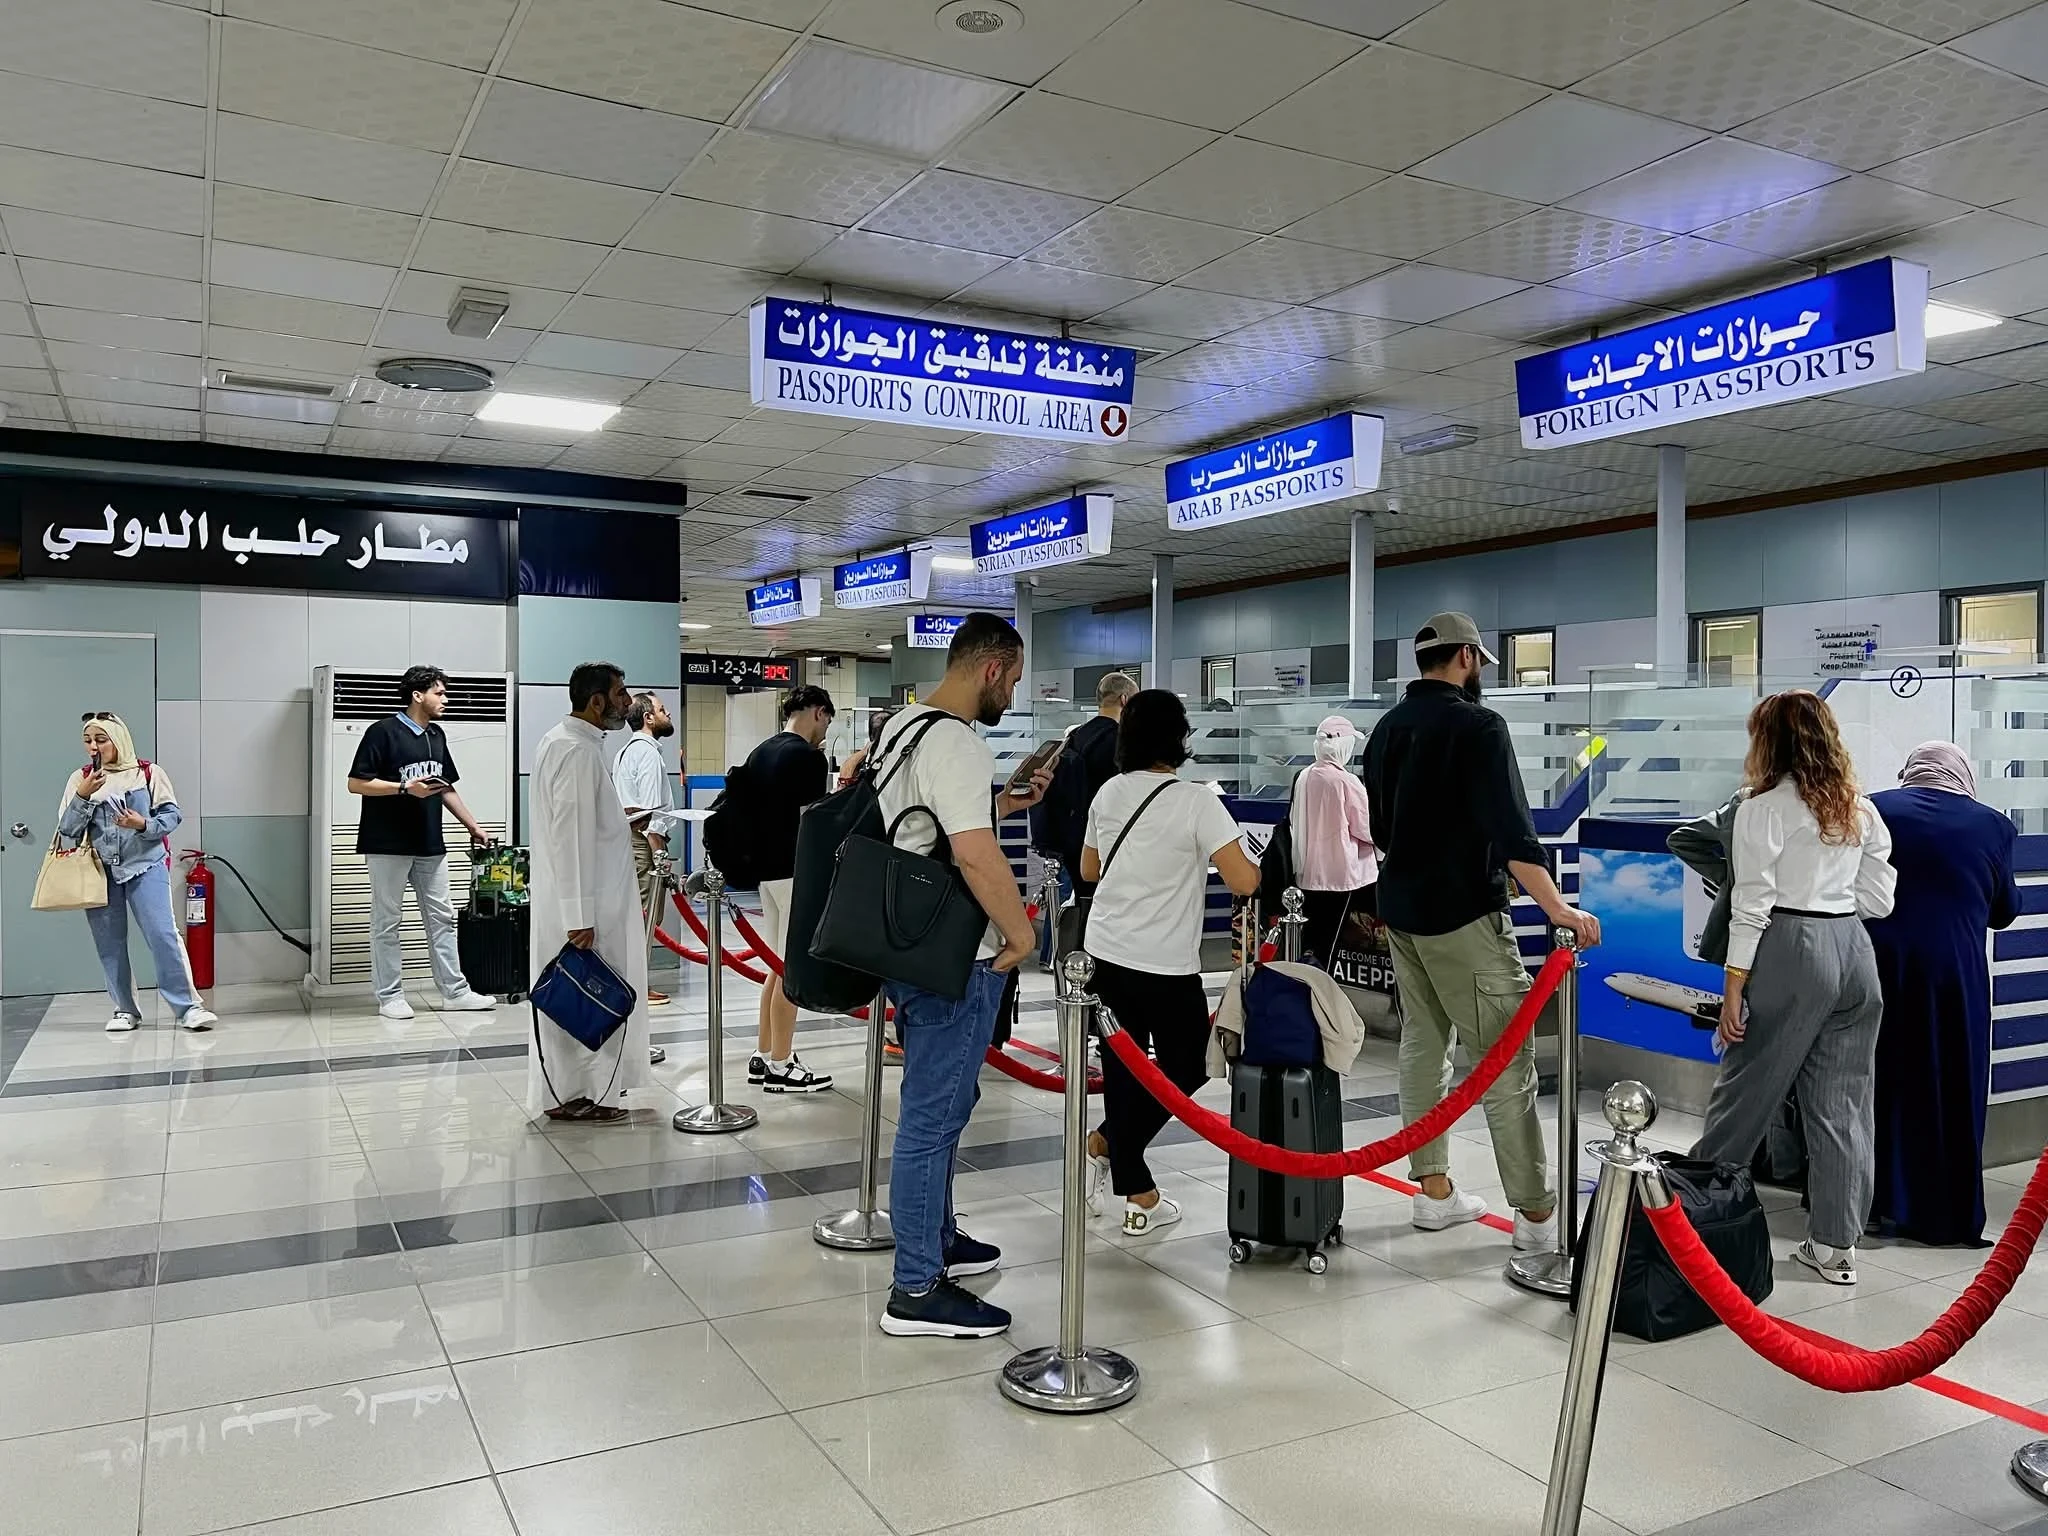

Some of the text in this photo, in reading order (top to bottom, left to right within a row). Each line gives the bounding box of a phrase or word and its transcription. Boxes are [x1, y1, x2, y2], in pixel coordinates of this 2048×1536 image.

[778, 307, 1124, 388] منطقة تدقيق الجوازات
[1566, 309, 1821, 400] جوازات الاجانب
[777, 366, 1094, 433] PASSPORTS CONTROL AREA
[1535, 340, 1876, 440] FOREIGN PASSPORTS
[1189, 438, 1318, 493] جوازات العرب
[1175, 466, 1344, 524] ARAB PASSPORTS
[42, 503, 469, 569] مطار حلب الدولي
[1029, 516, 1068, 539] جوازات
[977, 536, 1083, 574] SYRIAN PASSPORTS
[836, 582, 907, 605] SYRIAN PASSPORTS
[750, 608, 779, 624] DOMESTIC
[925, 617, 961, 633] وازات
[916, 634, 953, 646] PASSPO
[711, 659, 761, 676] 1-2-3-4
[1841, 661, 1864, 669] Clean
[1333, 960, 1396, 989] ALEPP
[1380, 956, 1392, 968] TO
